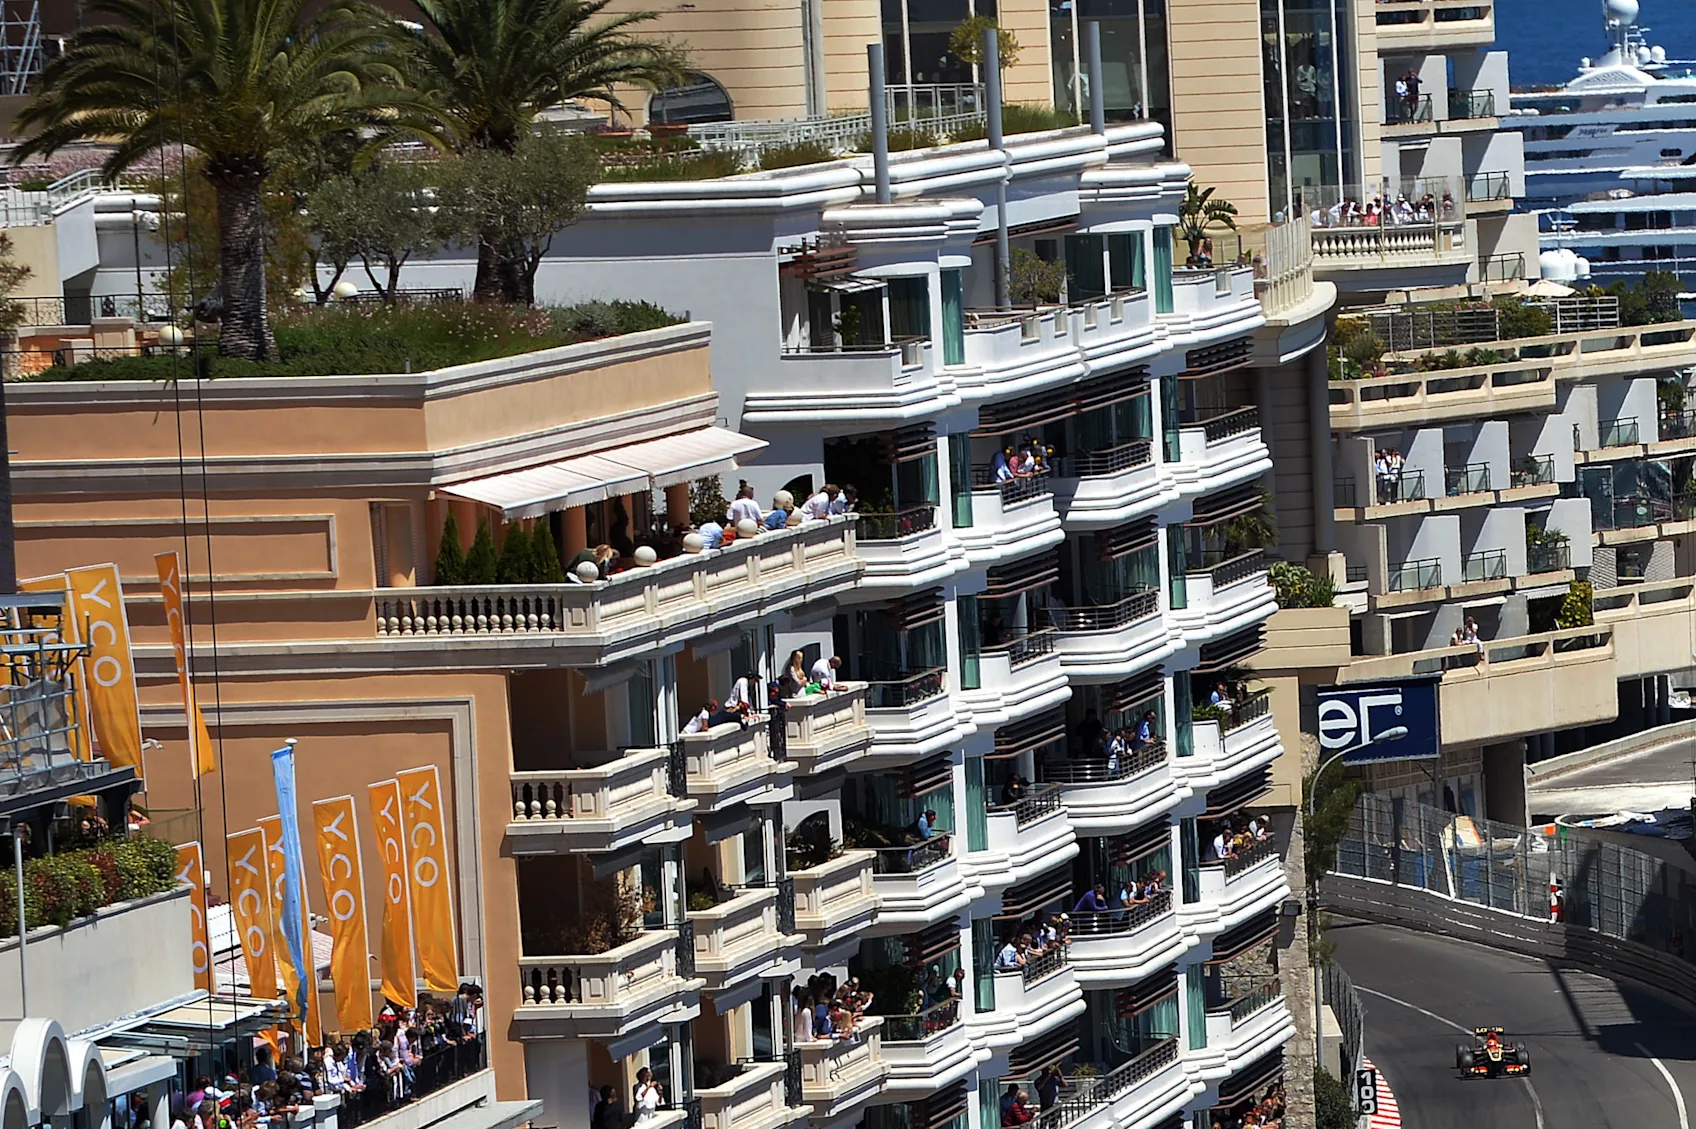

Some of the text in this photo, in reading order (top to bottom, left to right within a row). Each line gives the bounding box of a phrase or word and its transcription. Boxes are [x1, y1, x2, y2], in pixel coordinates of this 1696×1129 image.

[323, 811, 356, 921] Y.CO
[380, 796, 403, 904] Y.CO
[410, 780, 439, 888] Y.CO
[234, 845, 266, 958] Y.CO
[1361, 1071, 1375, 1114] 100
